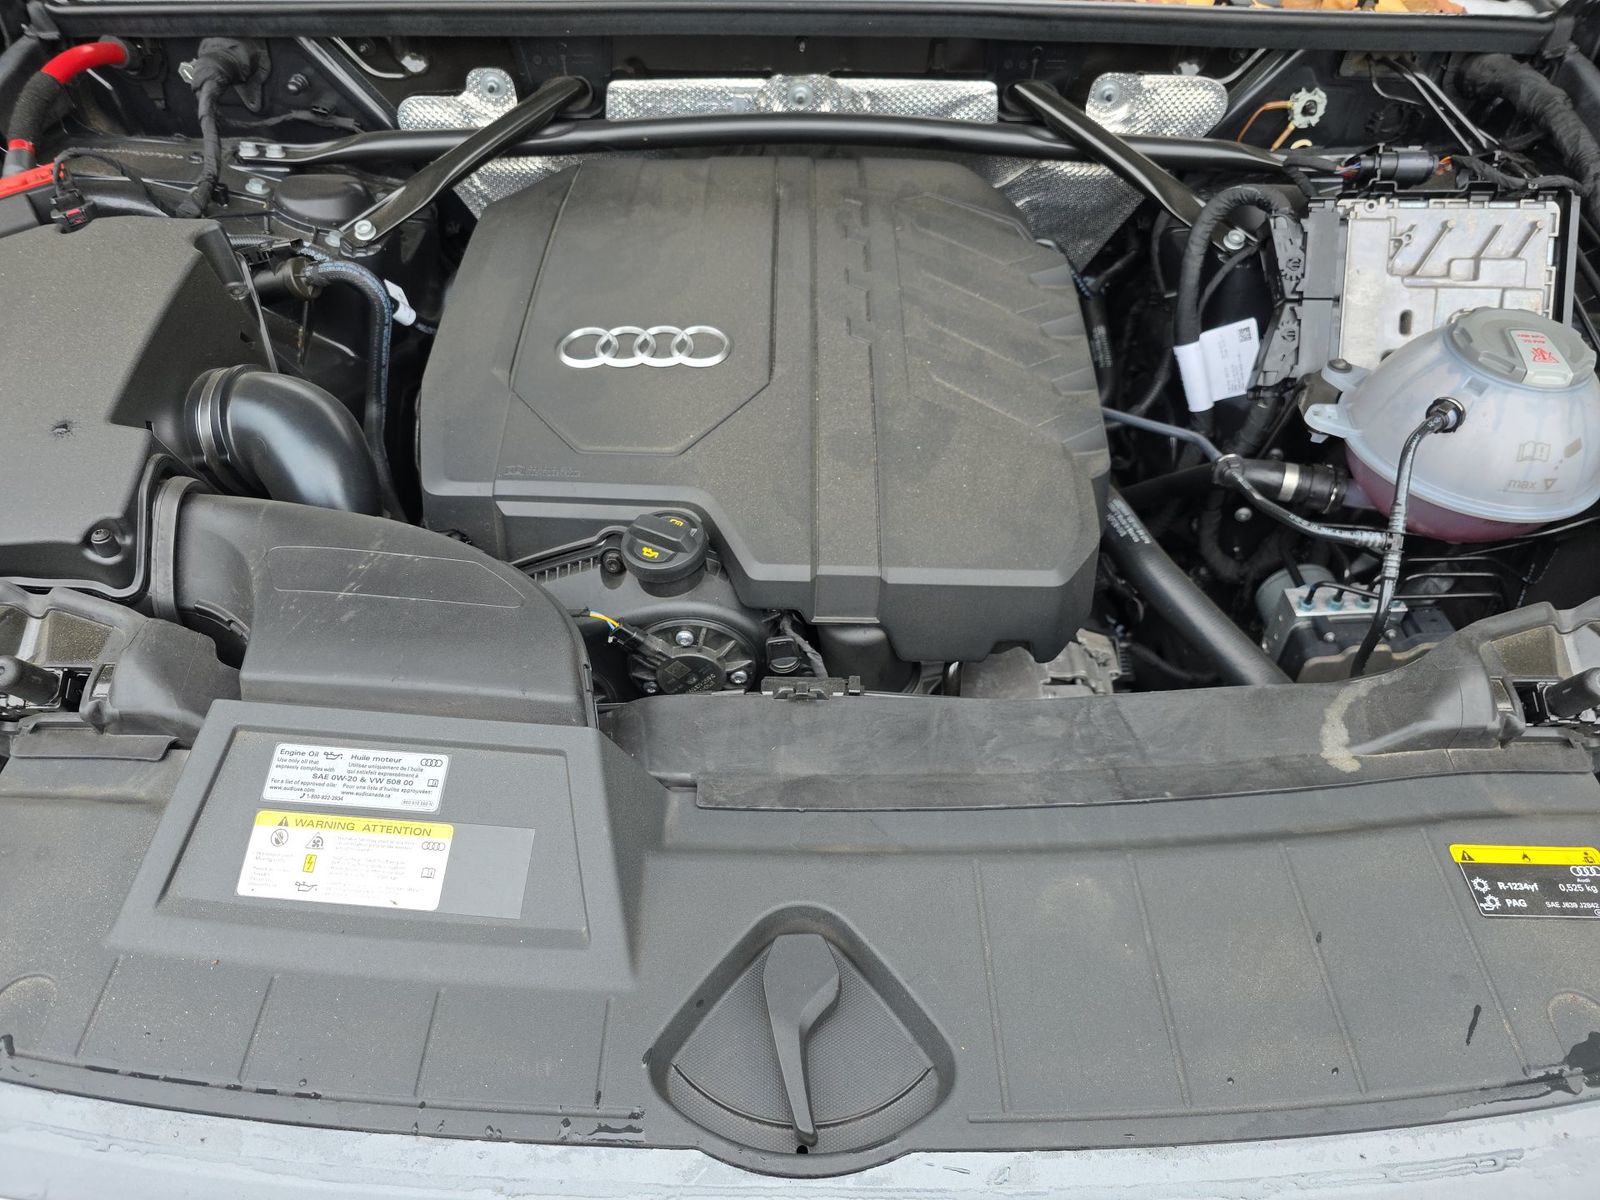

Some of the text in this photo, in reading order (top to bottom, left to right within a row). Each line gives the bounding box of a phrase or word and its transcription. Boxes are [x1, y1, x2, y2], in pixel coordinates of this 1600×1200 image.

[1508, 480, 1536, 489] max
[295, 819, 432, 836] WARNING ATTENTION
[1497, 882, 1598, 894] R-1234yf 0,525 kg
[1505, 899, 1528, 907] PAG
